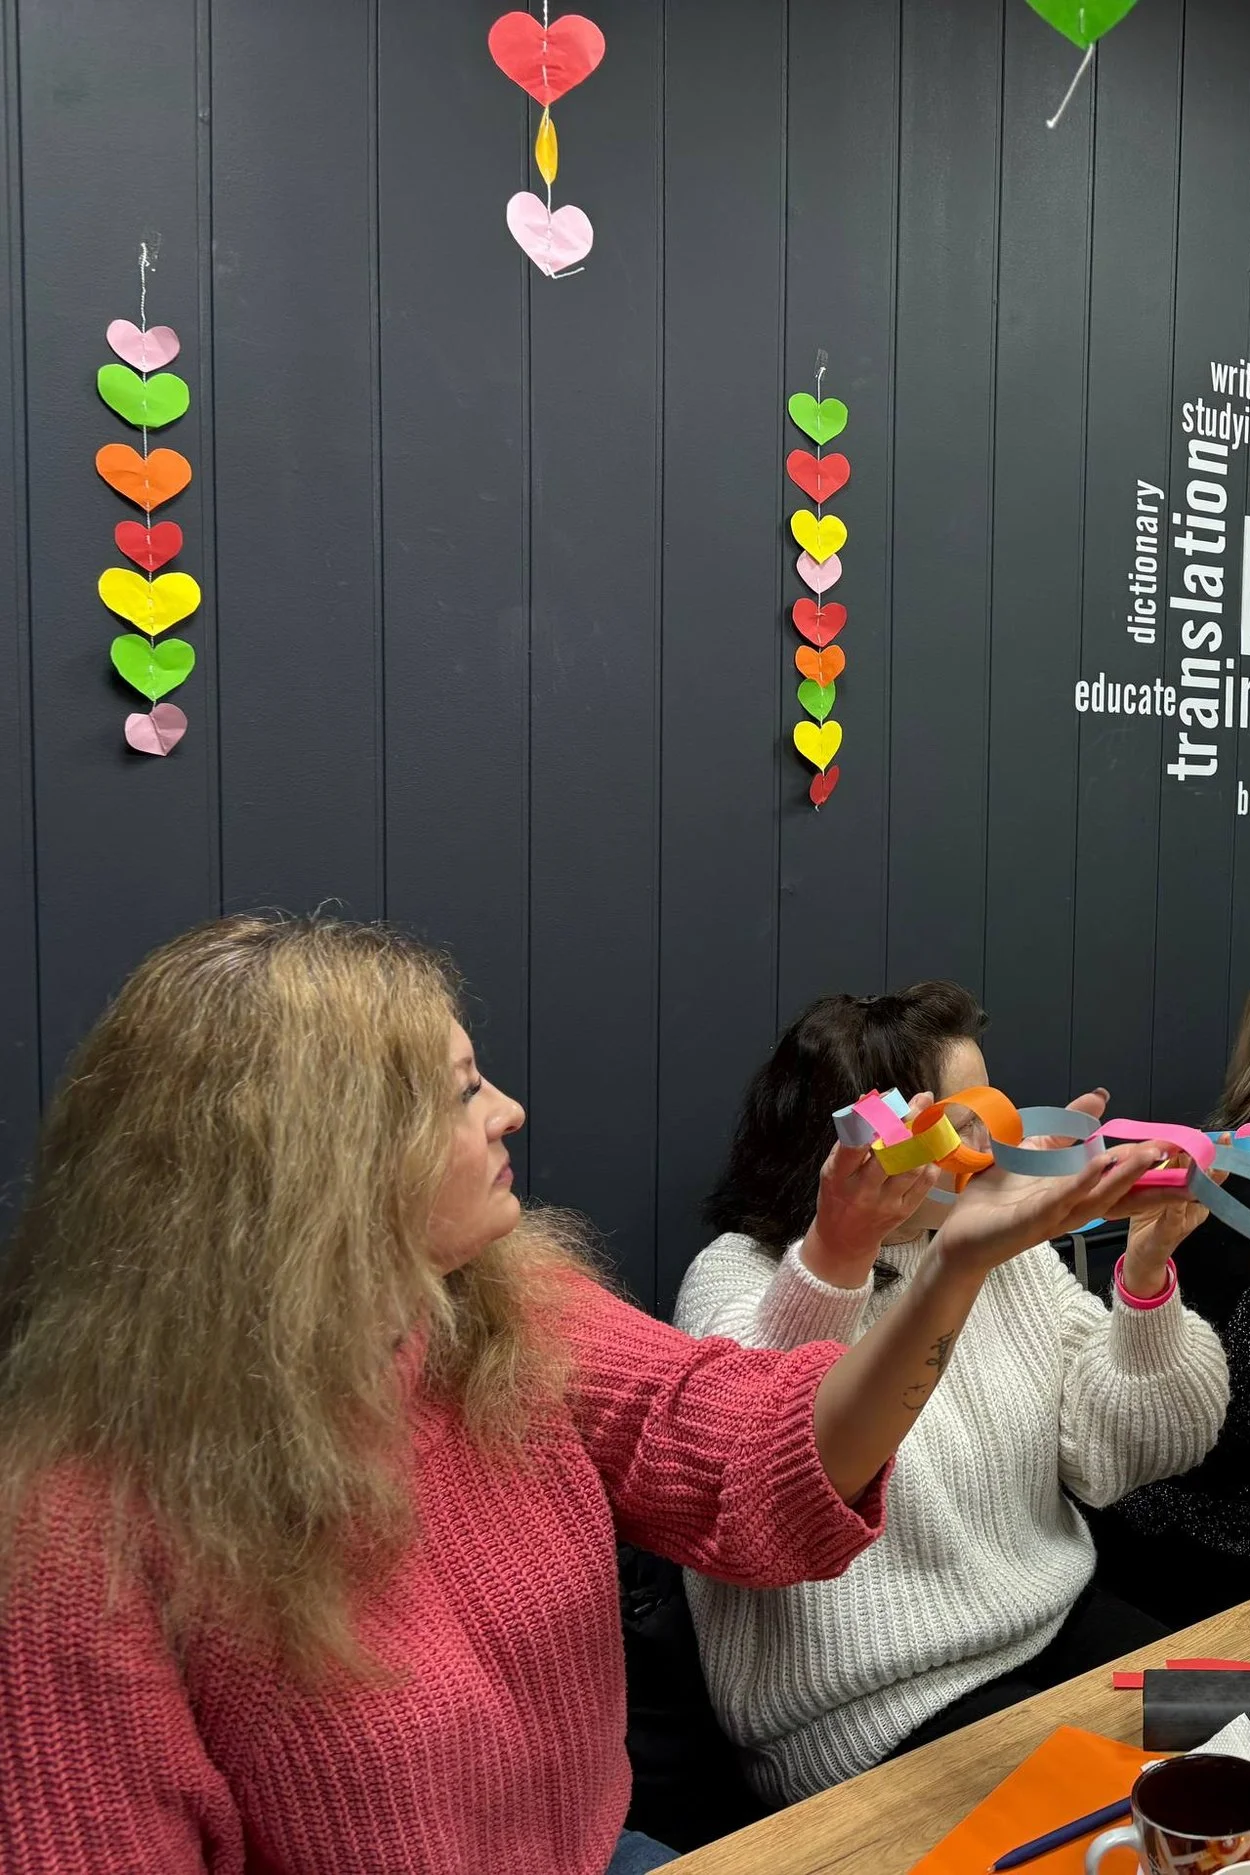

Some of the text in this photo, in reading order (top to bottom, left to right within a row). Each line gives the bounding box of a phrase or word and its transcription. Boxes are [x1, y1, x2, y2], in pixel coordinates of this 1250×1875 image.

[1127, 479, 1165, 644] dictionary
[1167, 438, 1229, 781] translation
[1074, 672, 1176, 716] educate
